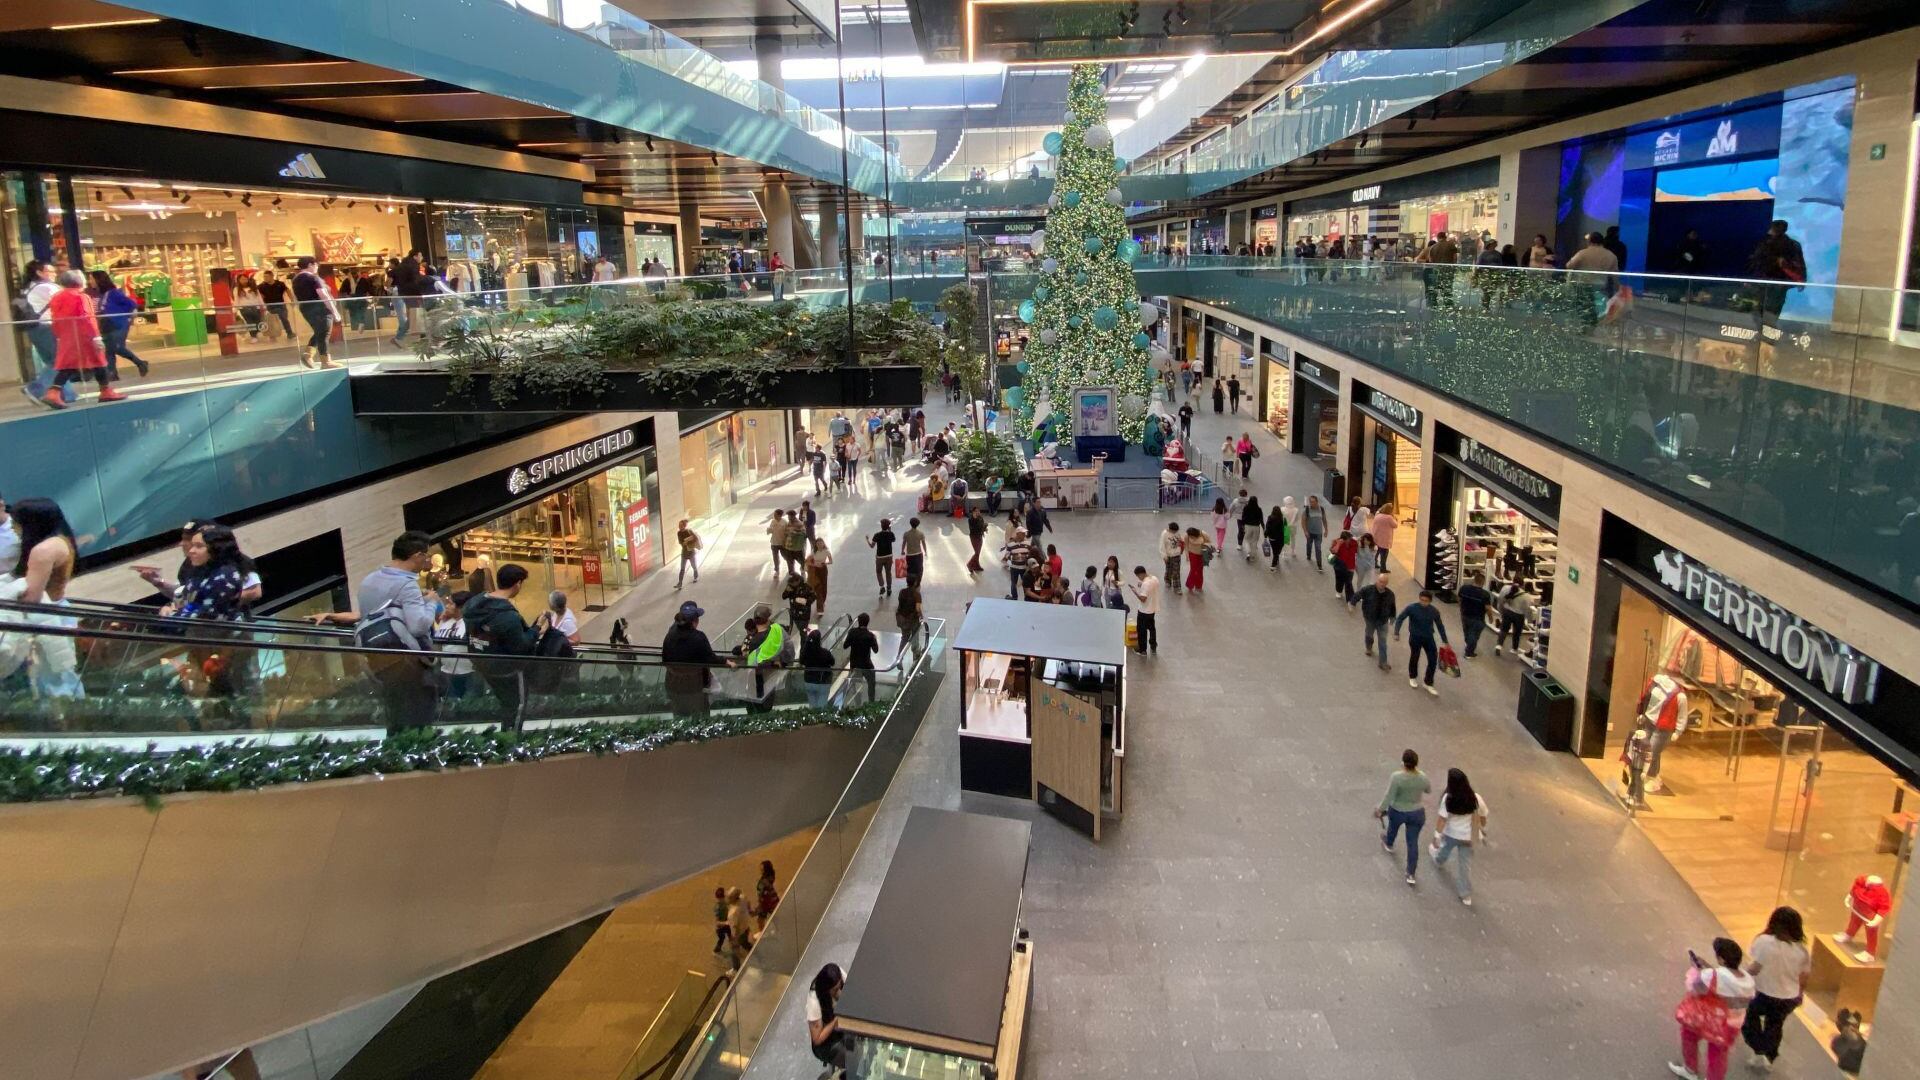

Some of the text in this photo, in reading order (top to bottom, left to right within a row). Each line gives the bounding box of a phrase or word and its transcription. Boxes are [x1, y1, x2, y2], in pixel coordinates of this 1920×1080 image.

[1352, 185, 1380, 203] OLD NAVY
[529, 429, 635, 484] SPRINGFIELD
[1685, 564, 1870, 704] FERRIONI
